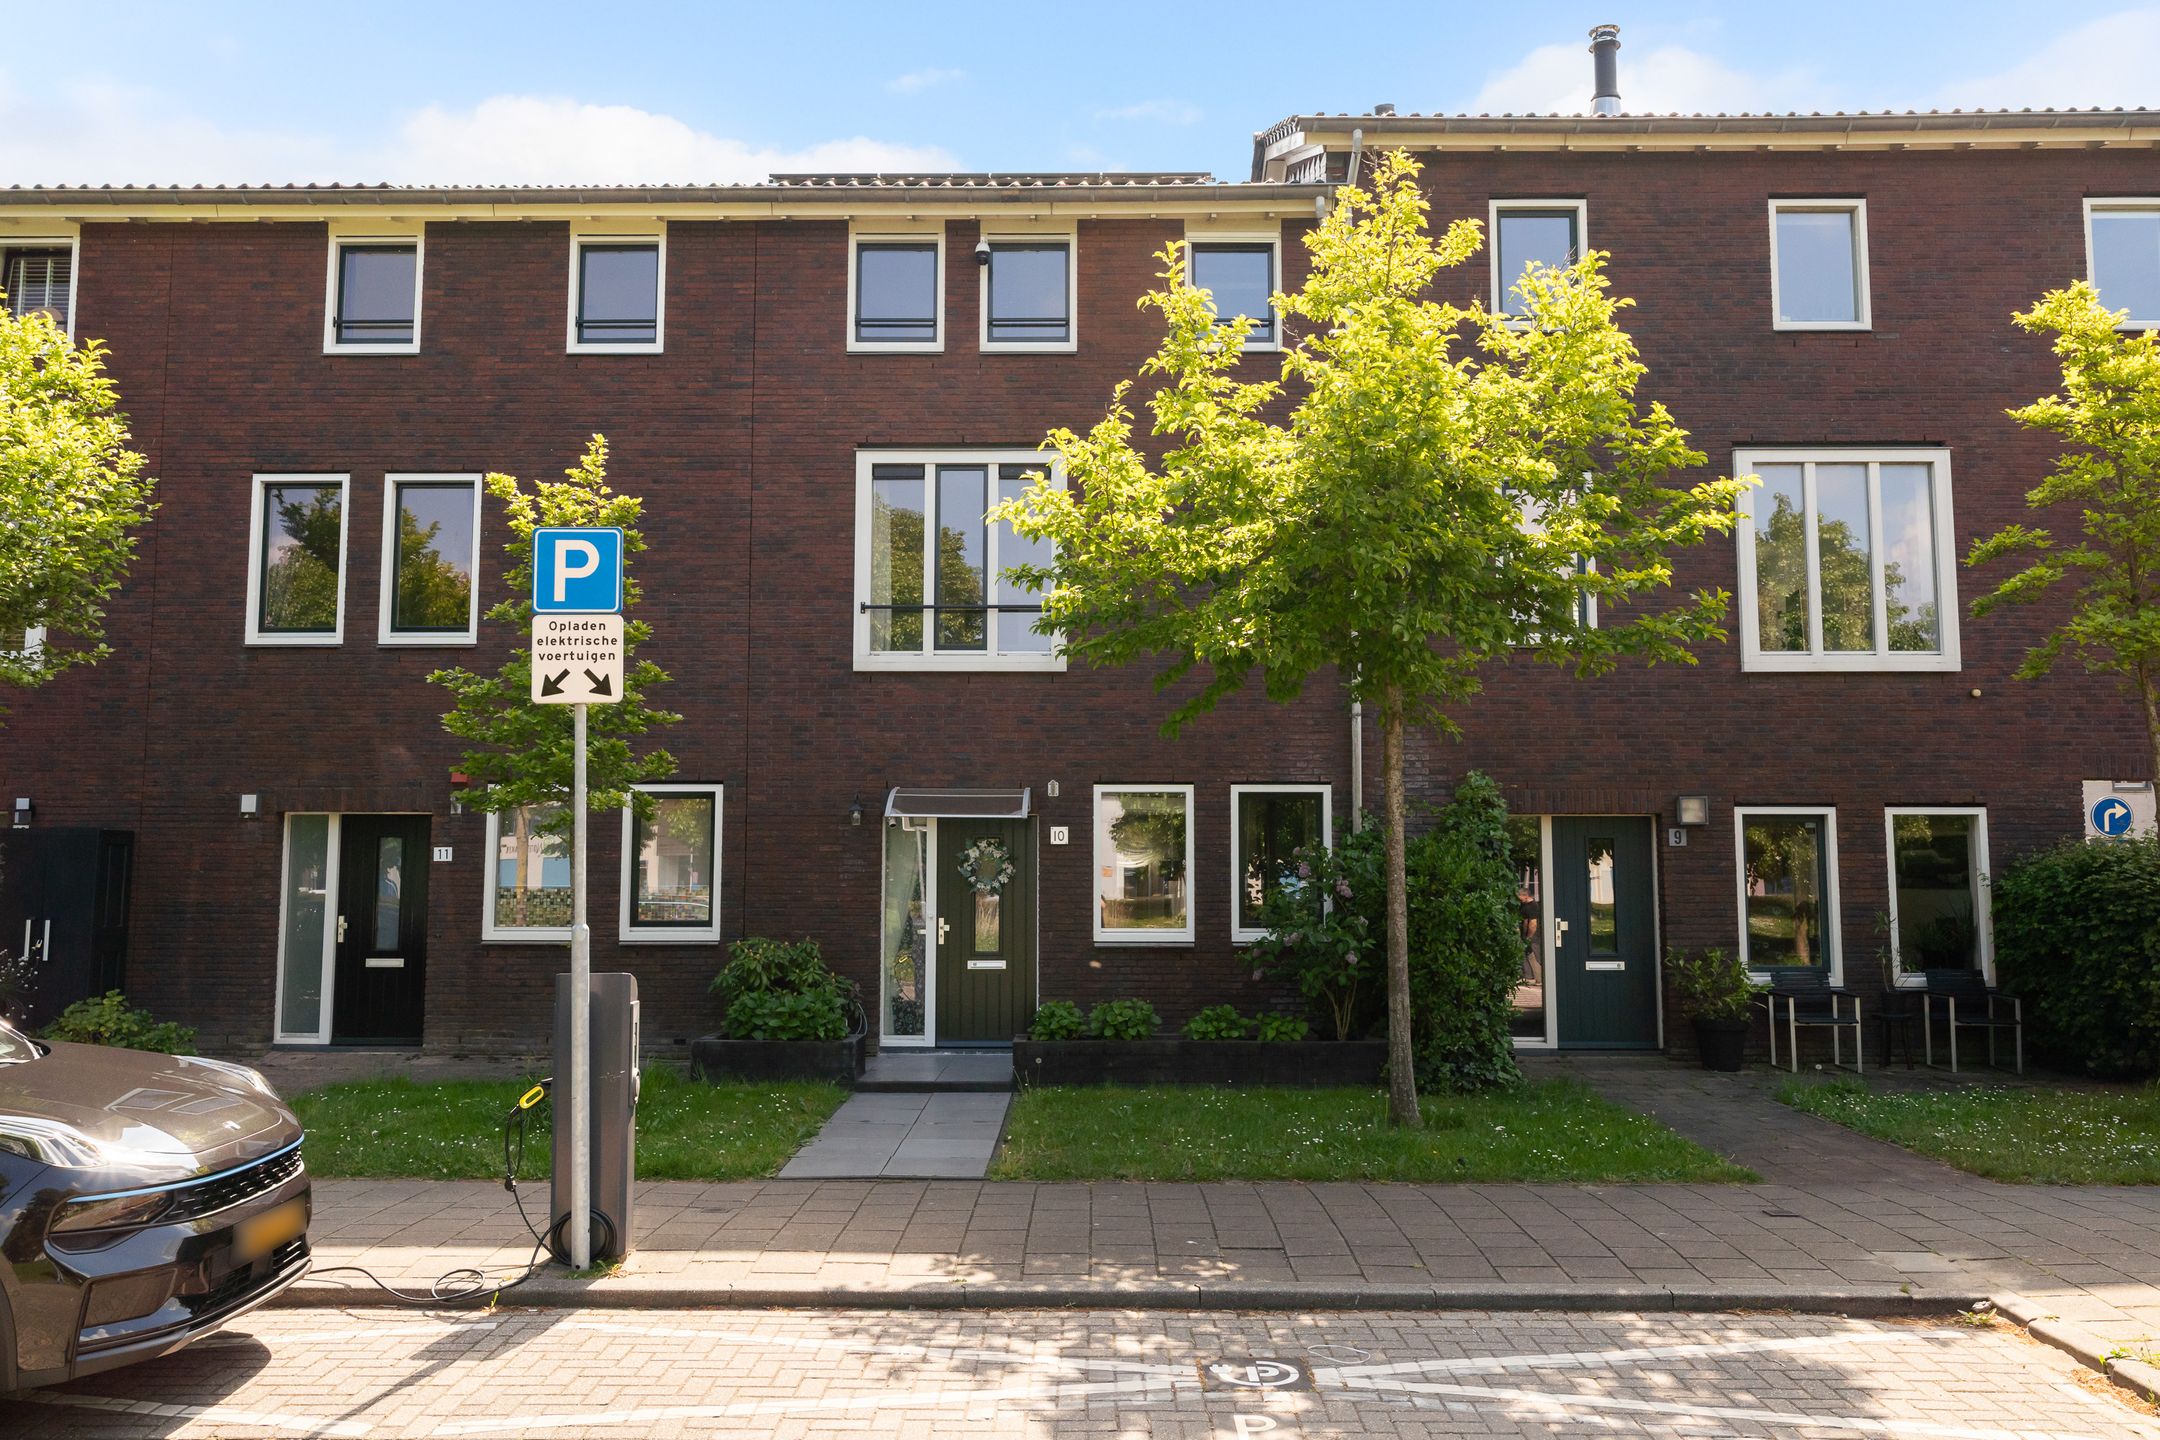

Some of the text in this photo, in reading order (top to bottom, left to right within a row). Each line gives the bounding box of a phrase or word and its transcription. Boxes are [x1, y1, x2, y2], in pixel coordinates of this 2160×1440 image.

[553, 539, 600, 602] P
[548, 620, 606, 633] Opladen
[536, 635, 618, 646] elektrische
[538, 651, 616, 664] voertuigen
[1053, 830, 1065, 842] 10
[1674, 830, 1682, 845] 9
[438, 848, 449, 860] 11
[1233, 1414, 1277, 1440] P
